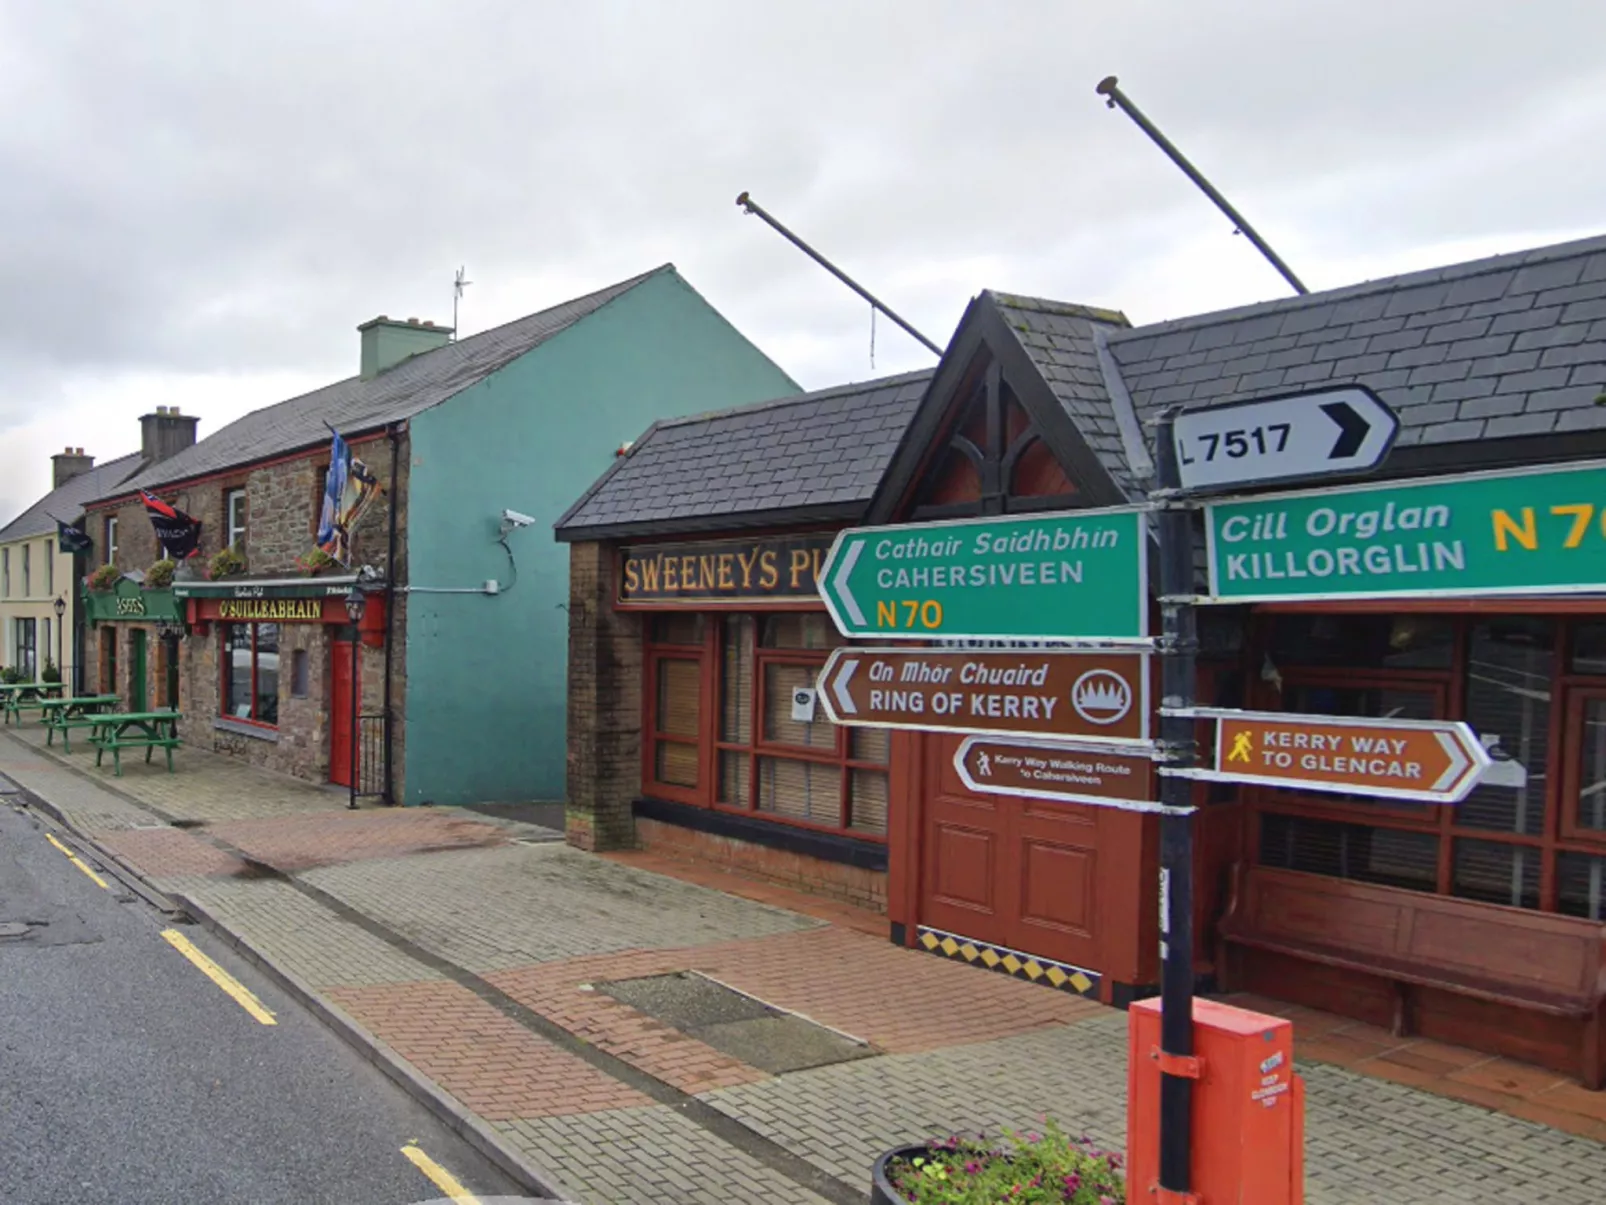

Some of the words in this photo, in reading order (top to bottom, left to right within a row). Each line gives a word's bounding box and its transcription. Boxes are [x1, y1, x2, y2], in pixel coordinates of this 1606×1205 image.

[1221, 511, 1288, 543] Cill
[1306, 503, 1451, 537] Orglan
[875, 535, 963, 560] Cathair
[1226, 540, 1465, 580] KILLORGLIN
[877, 561, 1083, 589] CAHERSIVEEN
[960, 662, 1048, 686] Chuaird
[870, 690, 924, 712] RING
[931, 692, 963, 714] OF
[971, 694, 1057, 719] KERRY
[1262, 731, 1342, 751] KERRY
[1351, 736, 1407, 756] WAY
[994, 754, 1022, 768] Kerry
[1025, 756, 1047, 769] Way
[1049, 758, 1094, 773] Walking
[1096, 762, 1132, 775] Route
[1033, 769, 1103, 785] Cahersiveen
[1262, 751, 1292, 768] TO
[1300, 753, 1422, 778] GLENCAR
